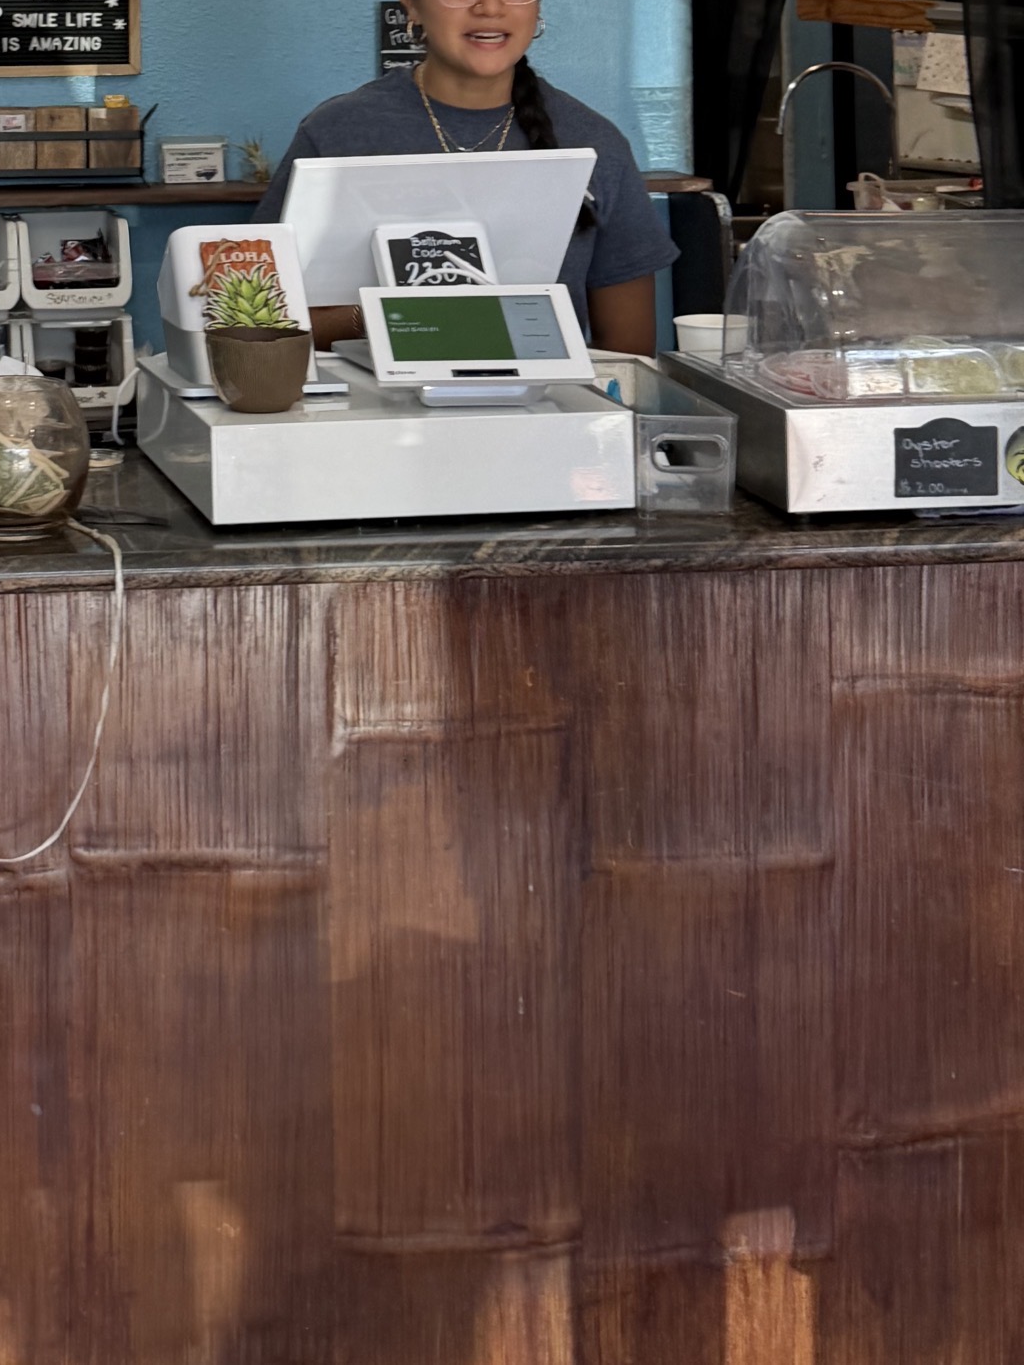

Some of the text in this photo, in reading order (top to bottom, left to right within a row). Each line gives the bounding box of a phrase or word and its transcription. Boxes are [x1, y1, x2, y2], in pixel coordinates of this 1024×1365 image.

[12, 12, 103, 28] SMILE LIFE
[2, 36, 102, 52] IS AMAZING
